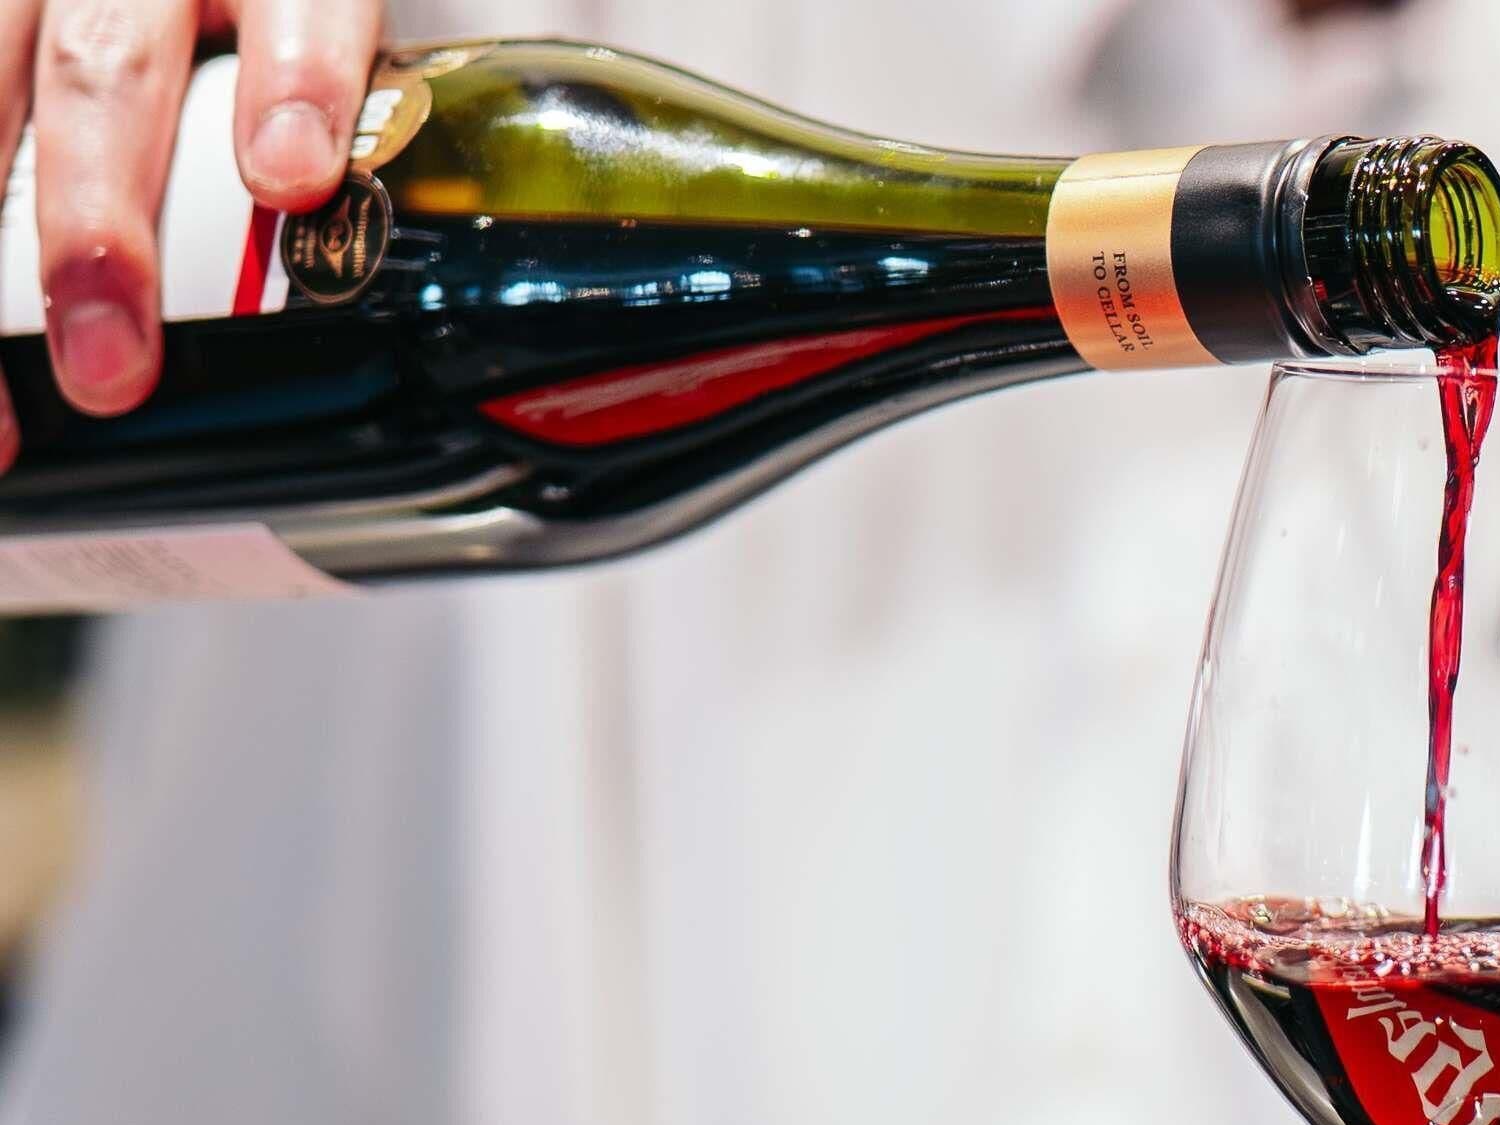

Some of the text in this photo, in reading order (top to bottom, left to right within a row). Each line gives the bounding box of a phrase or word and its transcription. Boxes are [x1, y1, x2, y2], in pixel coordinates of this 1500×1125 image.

[1092, 251, 1136, 353] TO CELLAR
[1113, 251, 1154, 350] FROM SOIL
